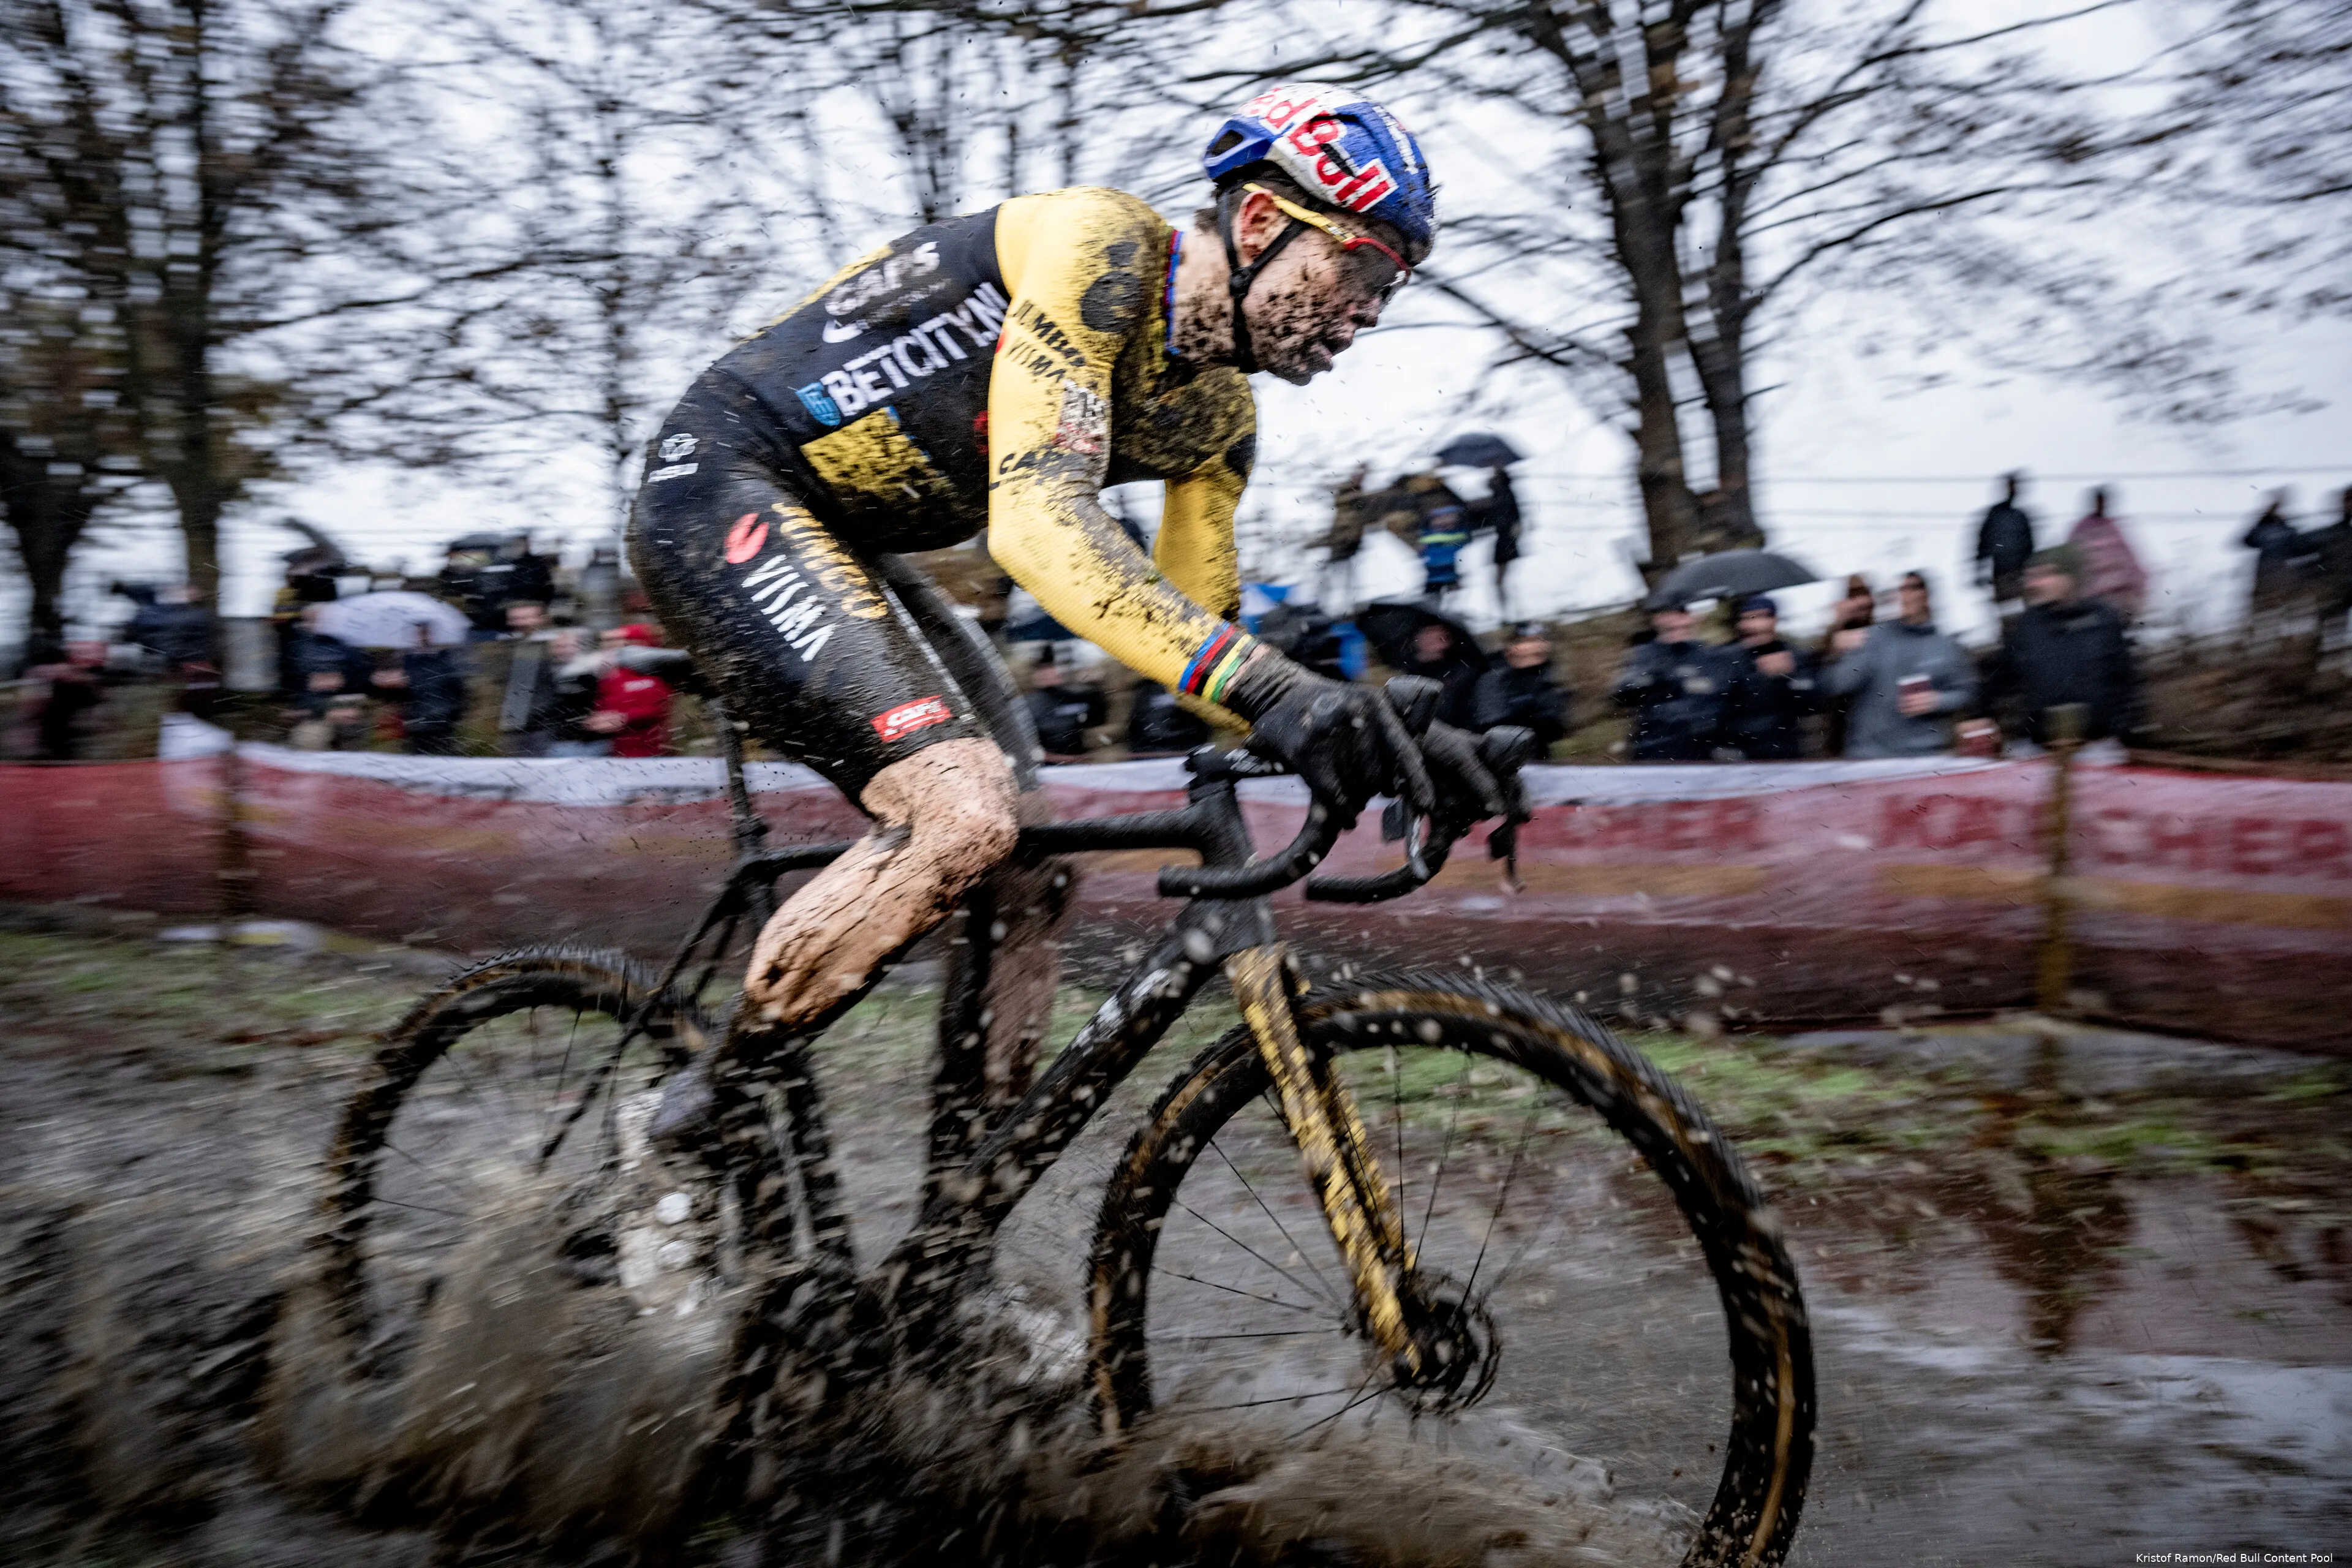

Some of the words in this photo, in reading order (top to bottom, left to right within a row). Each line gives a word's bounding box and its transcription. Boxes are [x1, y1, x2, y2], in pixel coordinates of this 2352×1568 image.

[1237, 86, 1319, 129] ed
[1287, 110, 1390, 211] Bull
[742, 554, 839, 662] VISMA
[771, 501, 889, 620] JUMBO
